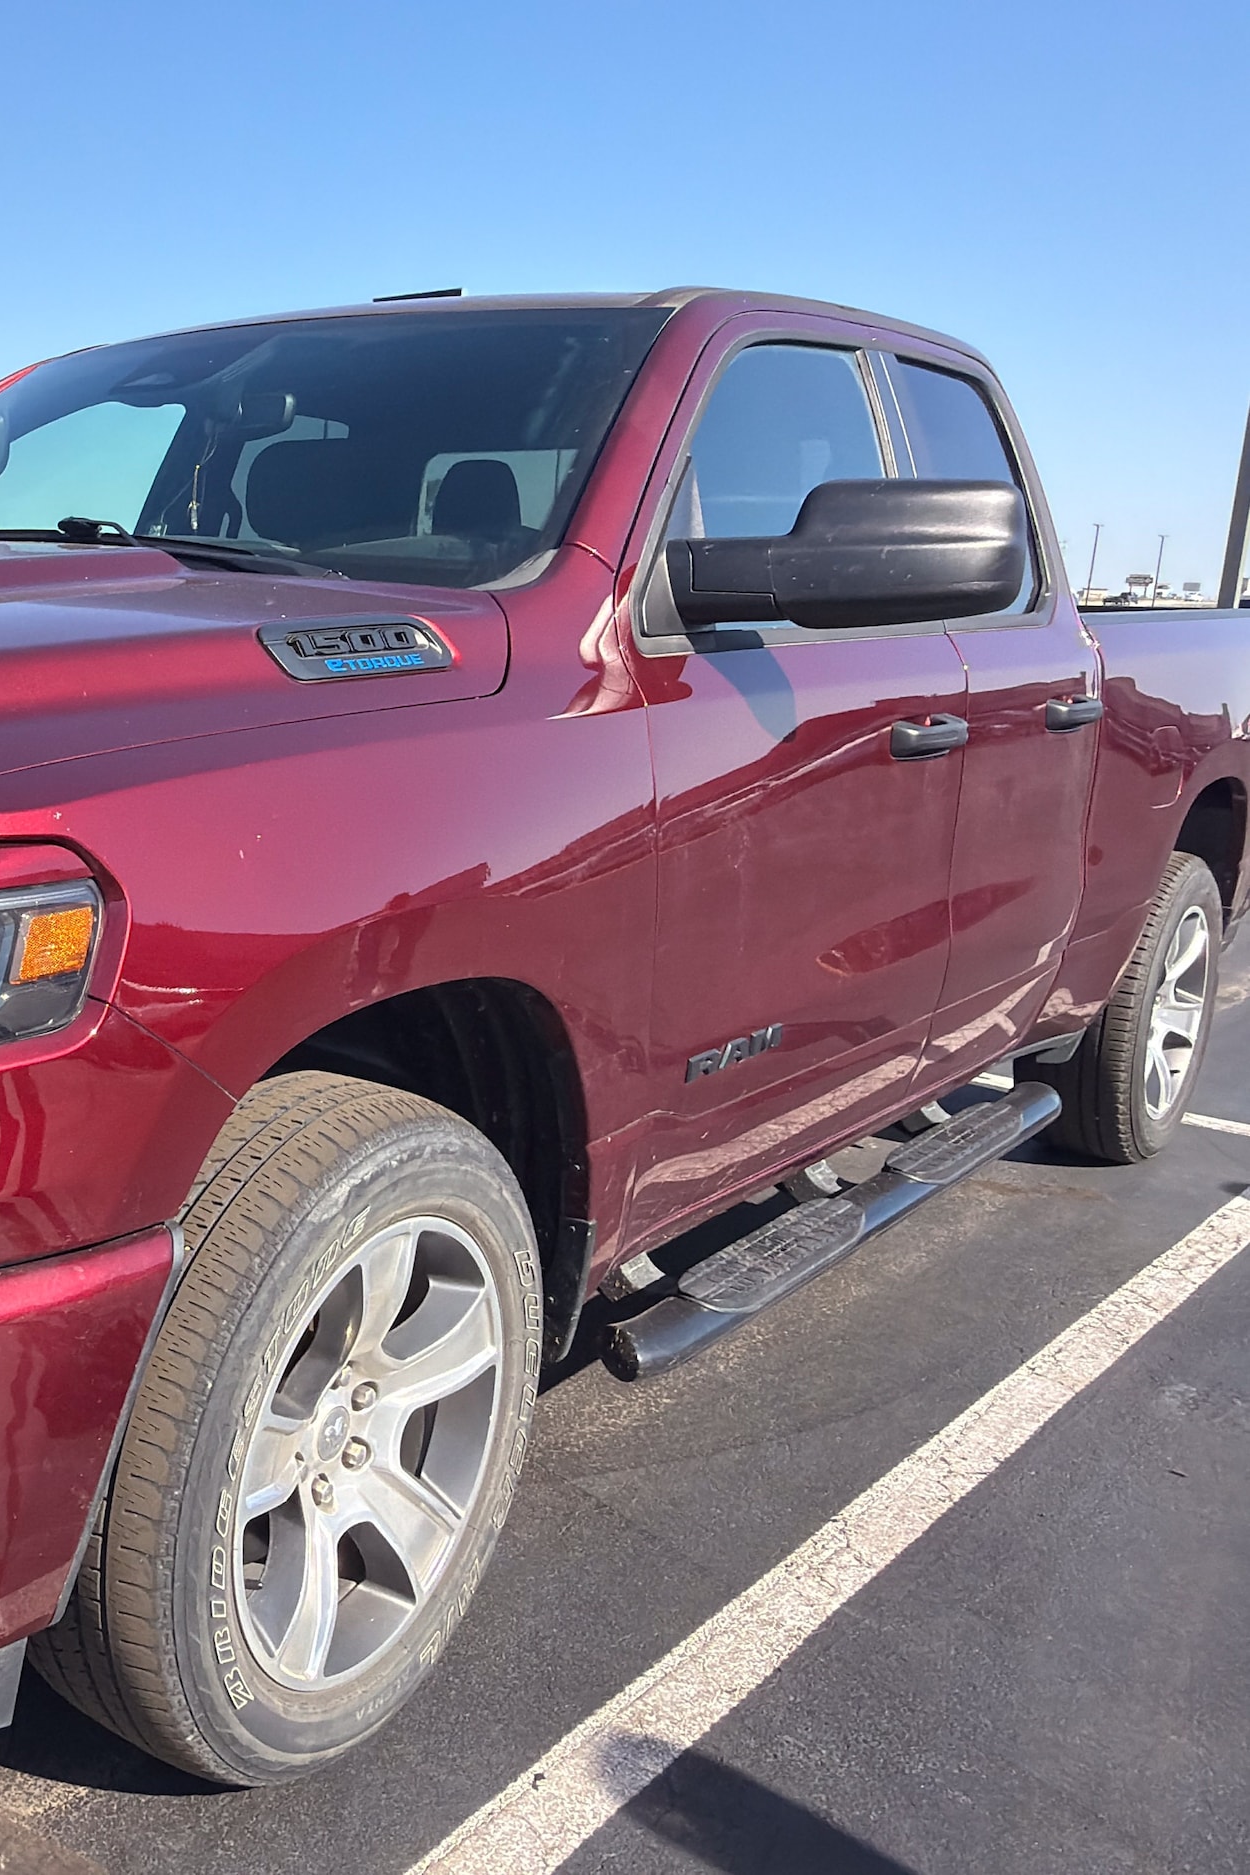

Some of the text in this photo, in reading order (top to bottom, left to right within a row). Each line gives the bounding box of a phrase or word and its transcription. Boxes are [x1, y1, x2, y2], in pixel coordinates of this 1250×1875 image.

[285, 627, 418, 658] 1500
[684, 1022, 783, 1085] RAM
[210, 1204, 371, 1710] BRIDGESTONE
[491, 1249, 541, 1529] DUELER
